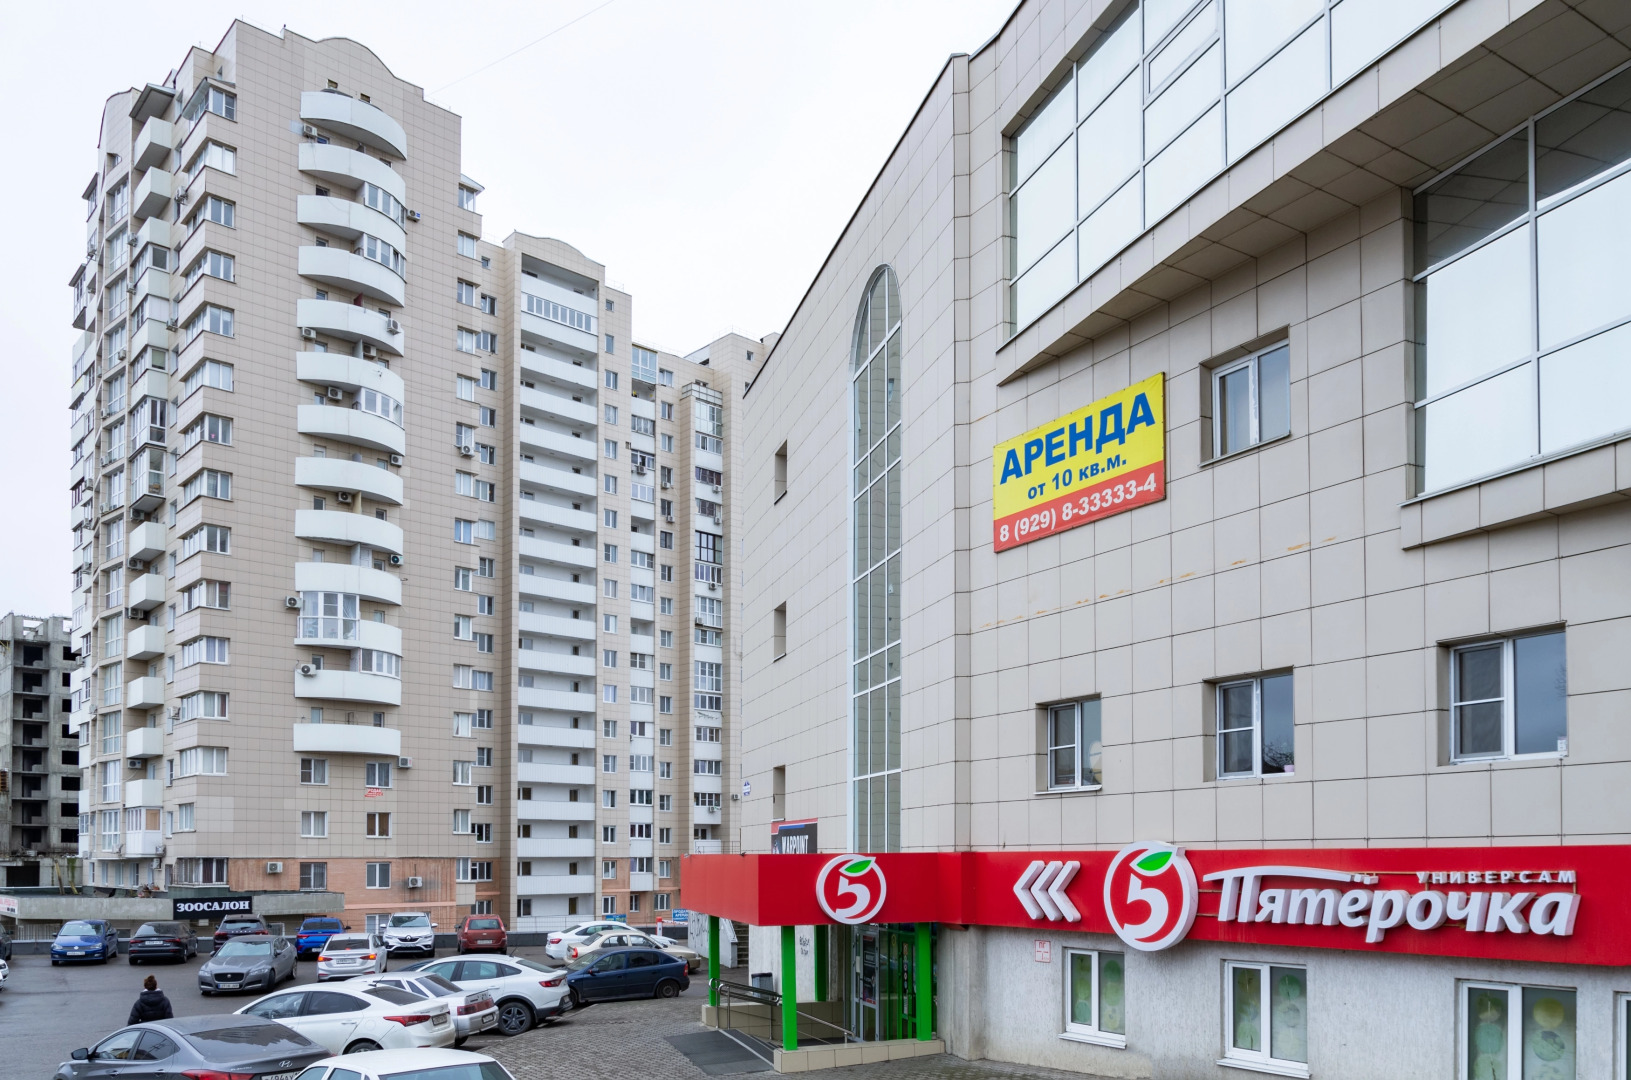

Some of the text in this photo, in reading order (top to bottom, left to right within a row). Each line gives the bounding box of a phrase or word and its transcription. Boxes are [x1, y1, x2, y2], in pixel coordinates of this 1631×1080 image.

[1000, 392, 1156, 485] АРЕНДА
[1027, 454, 1127, 500] от 10 кв.м.
[999, 472, 1157, 542] 8 (929) 8-33333-4
[1416, 869, 1576, 884] УНИВЕРСАМ
[176, 900, 250, 912] ЗООСАЛОН
